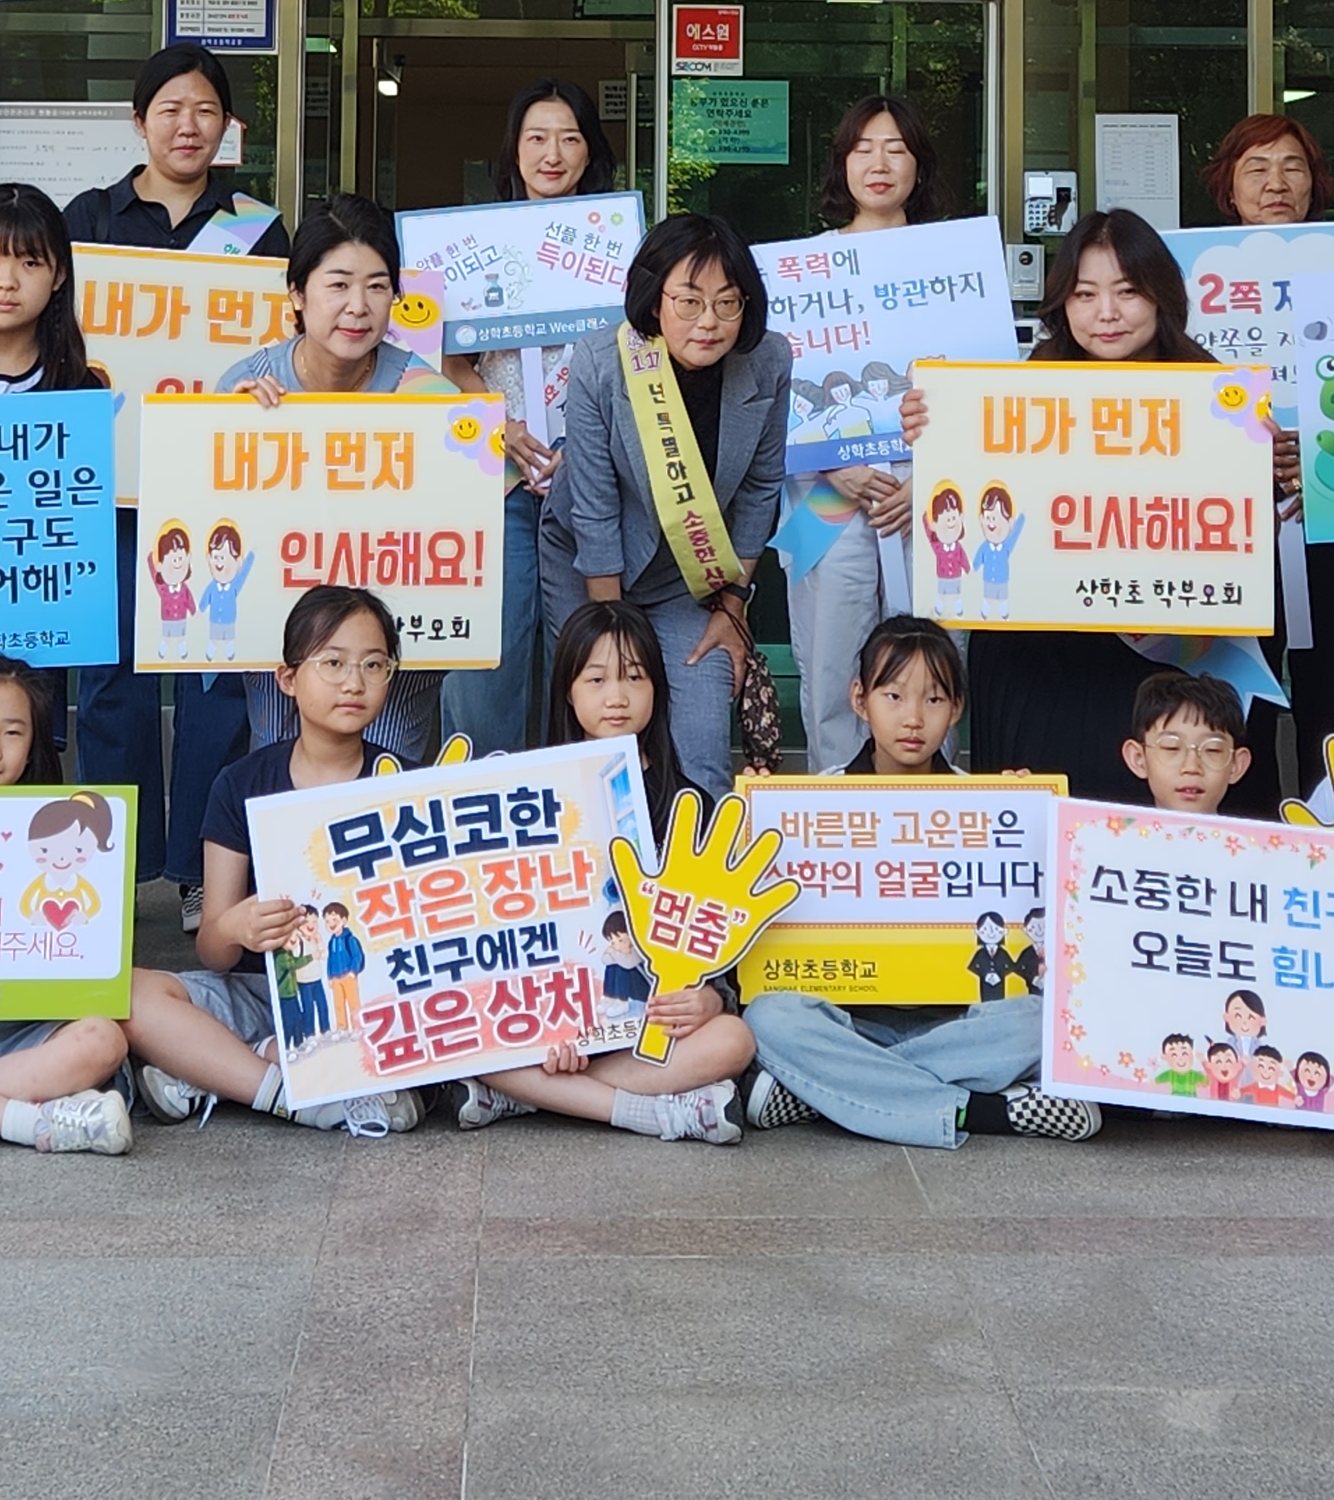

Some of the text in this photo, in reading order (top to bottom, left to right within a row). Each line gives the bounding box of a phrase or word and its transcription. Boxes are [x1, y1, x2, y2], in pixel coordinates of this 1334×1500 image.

[686, 24, 729, 41] 에스원
[675, 61, 711, 72] SECOM
[446, 244, 459, 258] 한
[584, 232, 601, 250] 한
[607, 240, 623, 260] 번
[777, 249, 860, 283] 폭력에
[82, 281, 190, 340] 내가
[874, 272, 985, 311] 방관하지
[1198, 273, 1262, 315] 2쪽
[479, 324, 547, 341] 상학초등학교
[983, 396, 1182, 456] 내가 먼저
[213, 432, 415, 490] 내가 먼저
[28, 467, 103, 508] 일은
[683, 510, 717, 564] 소중한
[1050, 495, 1254, 554] 인사해요!
[280, 531, 484, 588] 인사해요!
[1075, 578, 1144, 607] 상학초
[328, 786, 562, 881] 무심코한
[780, 810, 1024, 849] 바른말 고운말은
[355, 850, 595, 940] 작은 장난
[875, 861, 1044, 898] 얼굴입니다
[1089, 865, 1217, 918] 소중한
[1230, 879, 1268, 923] 내
[385, 922, 561, 994] 친구에겐
[763, 959, 878, 980] 상학초등학교
[1131, 930, 1257, 983] 오늘도
[363, 966, 596, 1073] 깊은 상처
